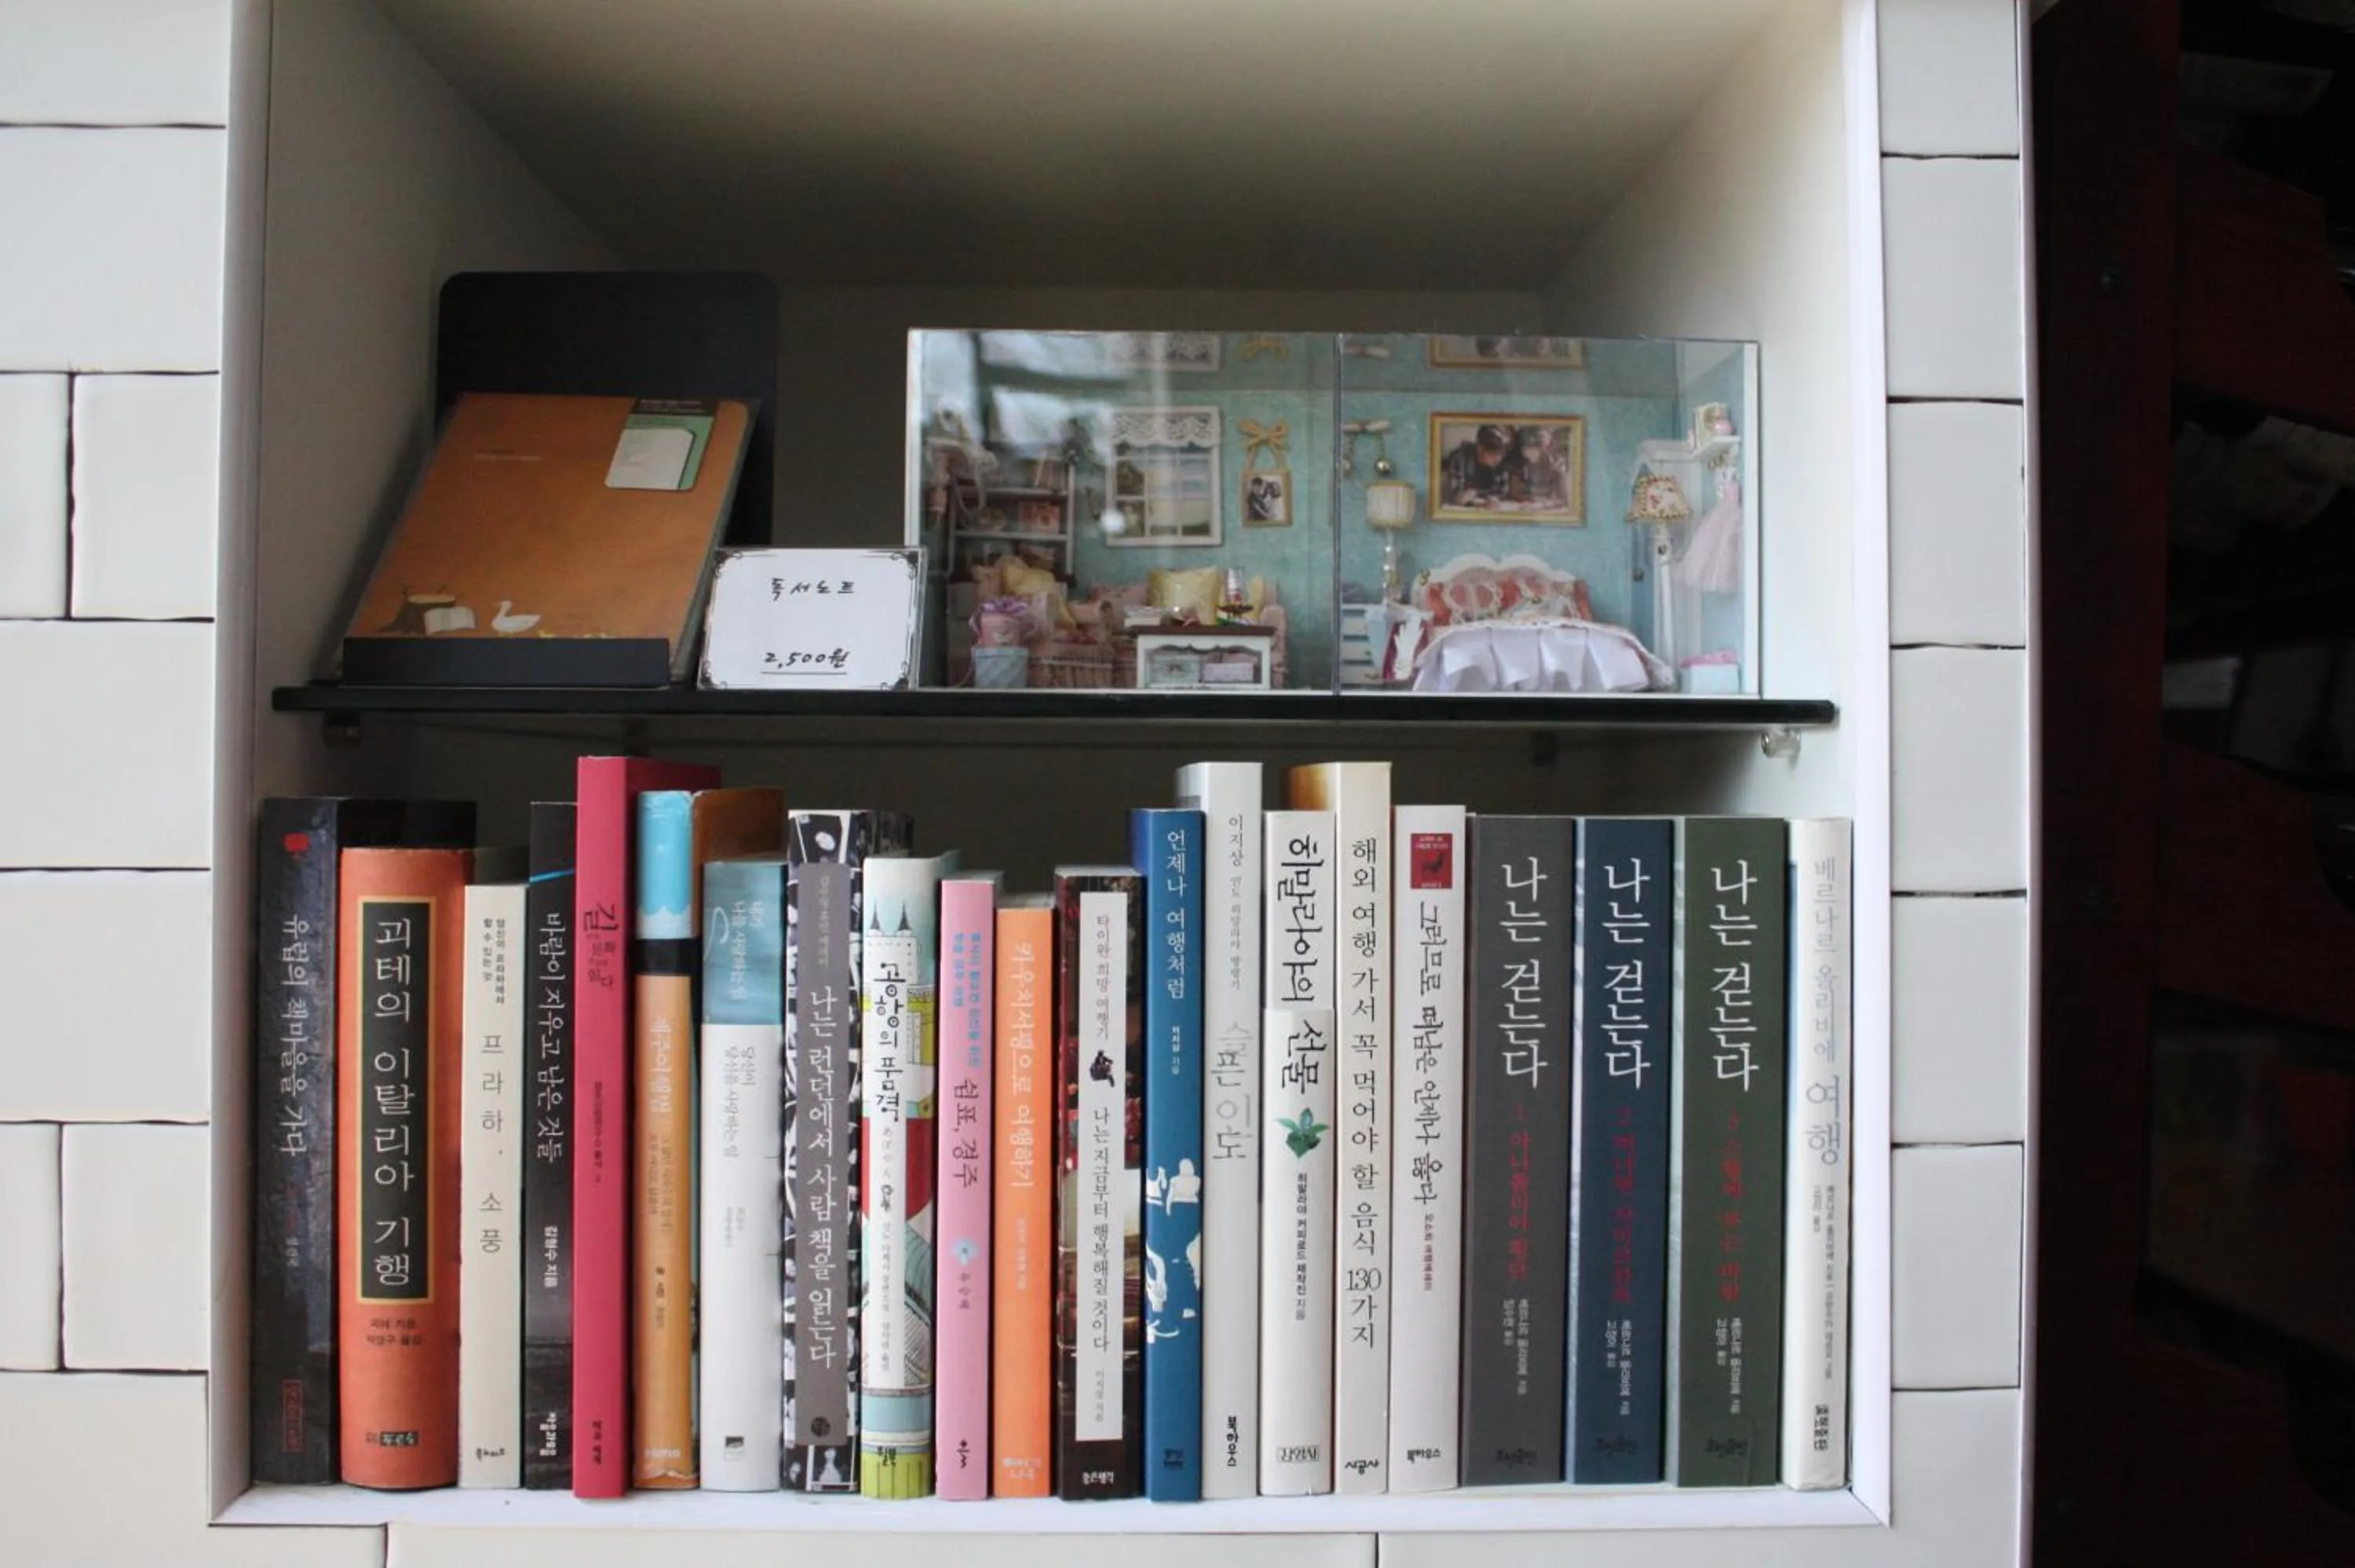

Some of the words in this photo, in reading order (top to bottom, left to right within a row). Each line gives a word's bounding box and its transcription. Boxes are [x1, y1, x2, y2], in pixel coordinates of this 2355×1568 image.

[764, 648, 849, 669] 2,500원
[1166, 829, 1188, 899] 언제나
[1351, 837, 1377, 893] 해외
[1499, 856, 1549, 943] 나는
[1277, 834, 1325, 1003] 히말라야의
[1351, 902, 1377, 958] 여행
[1601, 858, 1652, 944] 나는
[1709, 859, 1758, 946] 나는
[1813, 856, 1839, 954] 베르나르
[281, 913, 309, 986] 유럽의
[374, 917, 411, 1023] 괴테의
[538, 912, 565, 981] 바람이
[1164, 907, 1186, 1000] 여행처럼
[1419, 900, 1448, 996] 그러므로
[538, 987, 565, 1059] 지우고
[809, 986, 838, 1037] 나는
[1350, 967, 1379, 1023] 가서
[1498, 958, 1549, 1089] 걷는다
[1599, 959, 1652, 1091] 걷는다
[1708, 962, 1759, 1092] 걷는다
[1812, 964, 1839, 1064] 올리비에
[280, 997, 309, 1097] 책마을을
[1281, 1019, 1327, 1095] 선물
[1350, 1034, 1378, 1061] 꼭
[1412, 1005, 1444, 1074] 떠남은
[374, 1048, 415, 1191] 이탈리아
[537, 1067, 564, 1111] 남은
[808, 1045, 834, 1158] 런던에서
[1351, 1069, 1379, 1154] 먹어야
[1413, 1080, 1441, 1145] 언제나
[1803, 1074, 1841, 1167] 여행
[279, 1106, 307, 1156] 가다
[536, 1117, 564, 1164] 것들
[951, 1138, 980, 1189] 경주
[1010, 1104, 1035, 1187] 여행하기
[1351, 1163, 1379, 1191] 할
[1411, 1152, 1444, 1205] 옳다
[374, 1216, 410, 1285] 기행
[480, 1193, 504, 1253] 소풍
[1350, 1201, 1378, 1256] 음식
[809, 1288, 838, 1369] 읽는다
